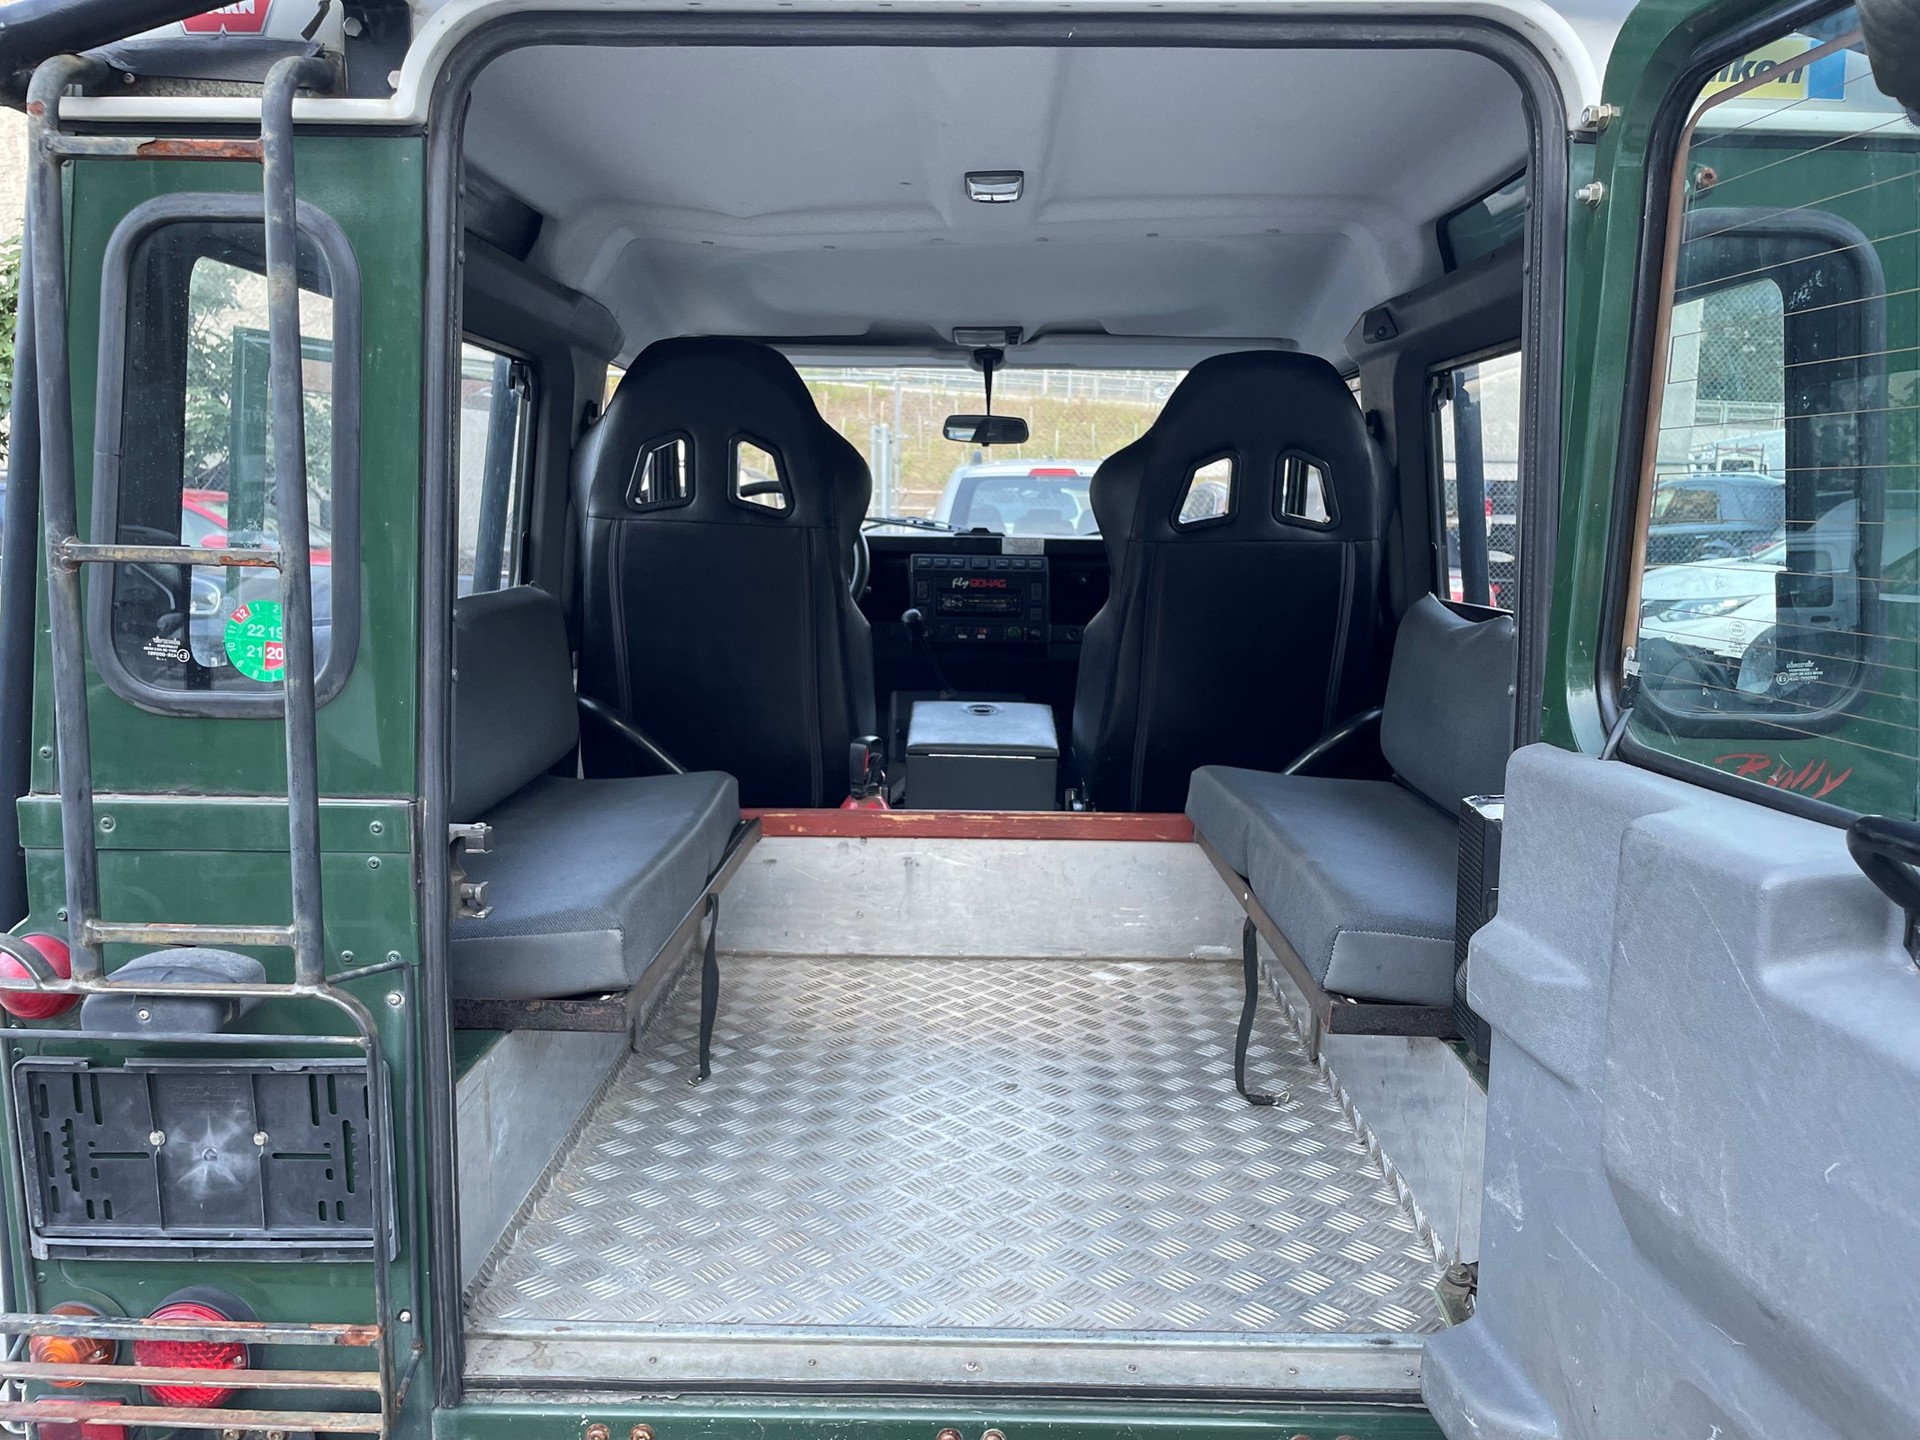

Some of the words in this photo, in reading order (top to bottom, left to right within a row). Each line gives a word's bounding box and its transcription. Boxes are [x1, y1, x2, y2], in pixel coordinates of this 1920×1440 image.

[1709, 55, 1803, 84] ikon
[235, 607, 249, 621] 12
[246, 623, 265, 637] 22
[246, 644, 263, 658] 21
[265, 646, 284, 660] 20
